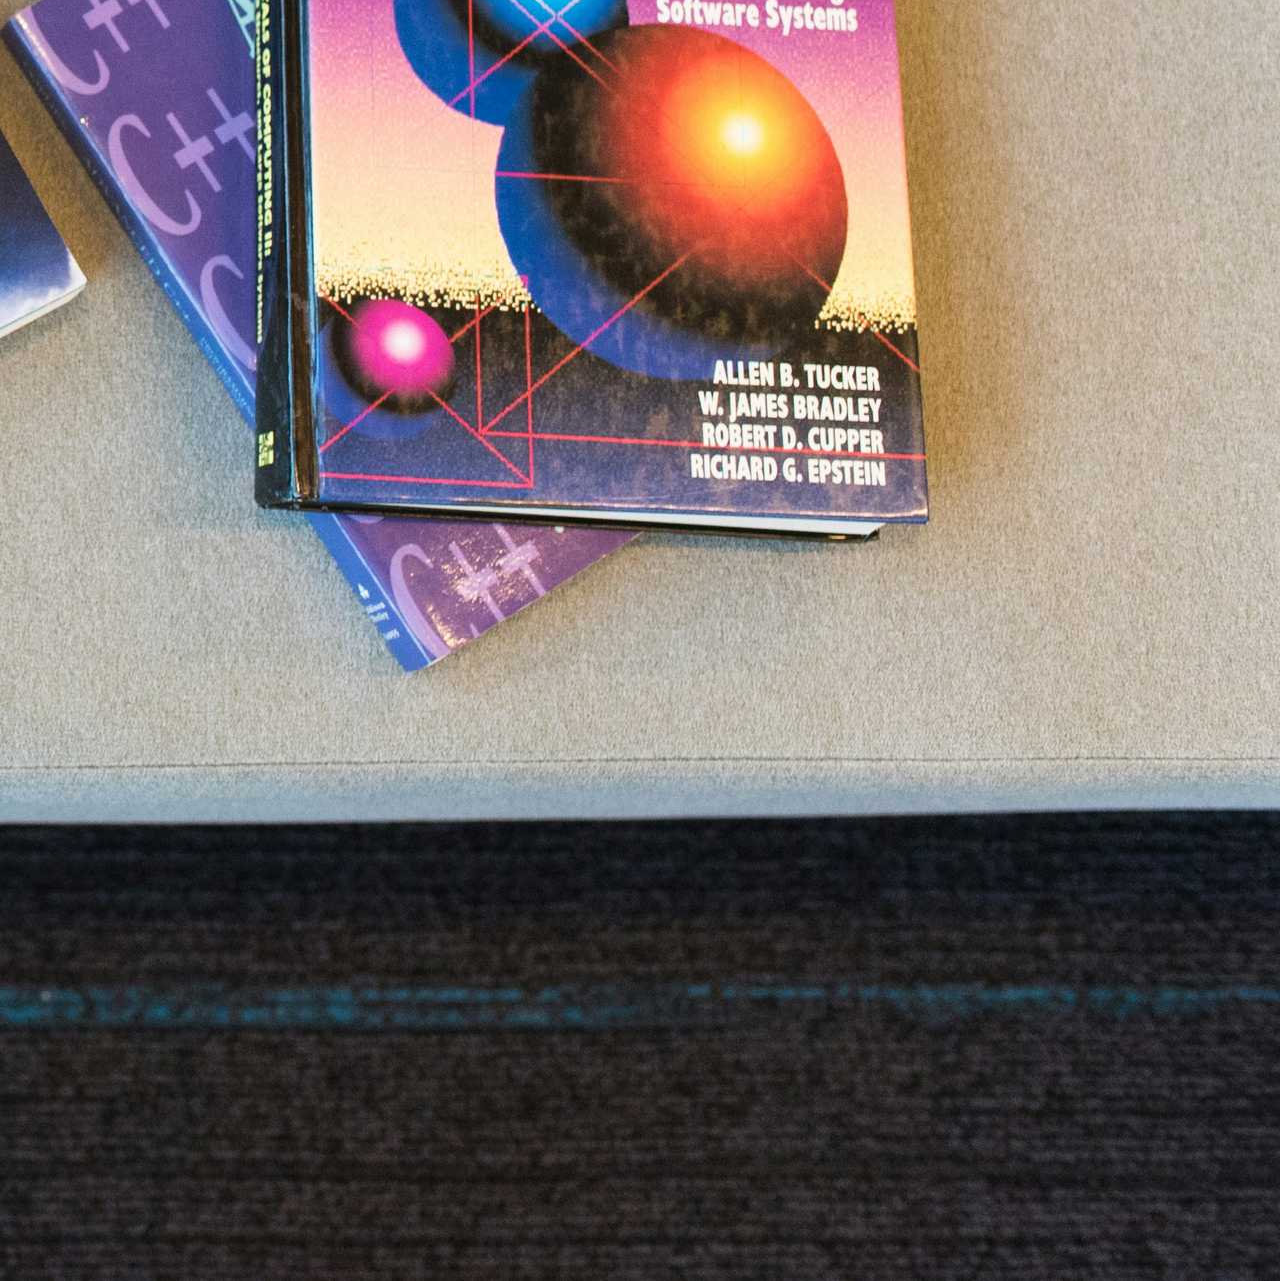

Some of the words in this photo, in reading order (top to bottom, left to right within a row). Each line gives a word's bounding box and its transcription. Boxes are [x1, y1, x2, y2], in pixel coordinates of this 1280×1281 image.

[261, 48, 271, 78] OF
[108, 87, 256, 236] C++
[262, 83, 274, 226] COMPUTING
[713, 359, 775, 387] ALLEN
[779, 362, 800, 388] B.
[803, 363, 881, 392] TUCKER
[698, 390, 724, 416] W.
[728, 392, 789, 423] JAMES
[793, 394, 882, 423] BRADLEY
[702, 422, 777, 450] ROBERT
[781, 425, 804, 451] D.
[807, 426, 885, 454] CUPPER
[690, 453, 778, 481] RICHARD
[782, 457, 803, 483] G.
[807, 458, 887, 487] EPSTEIN
